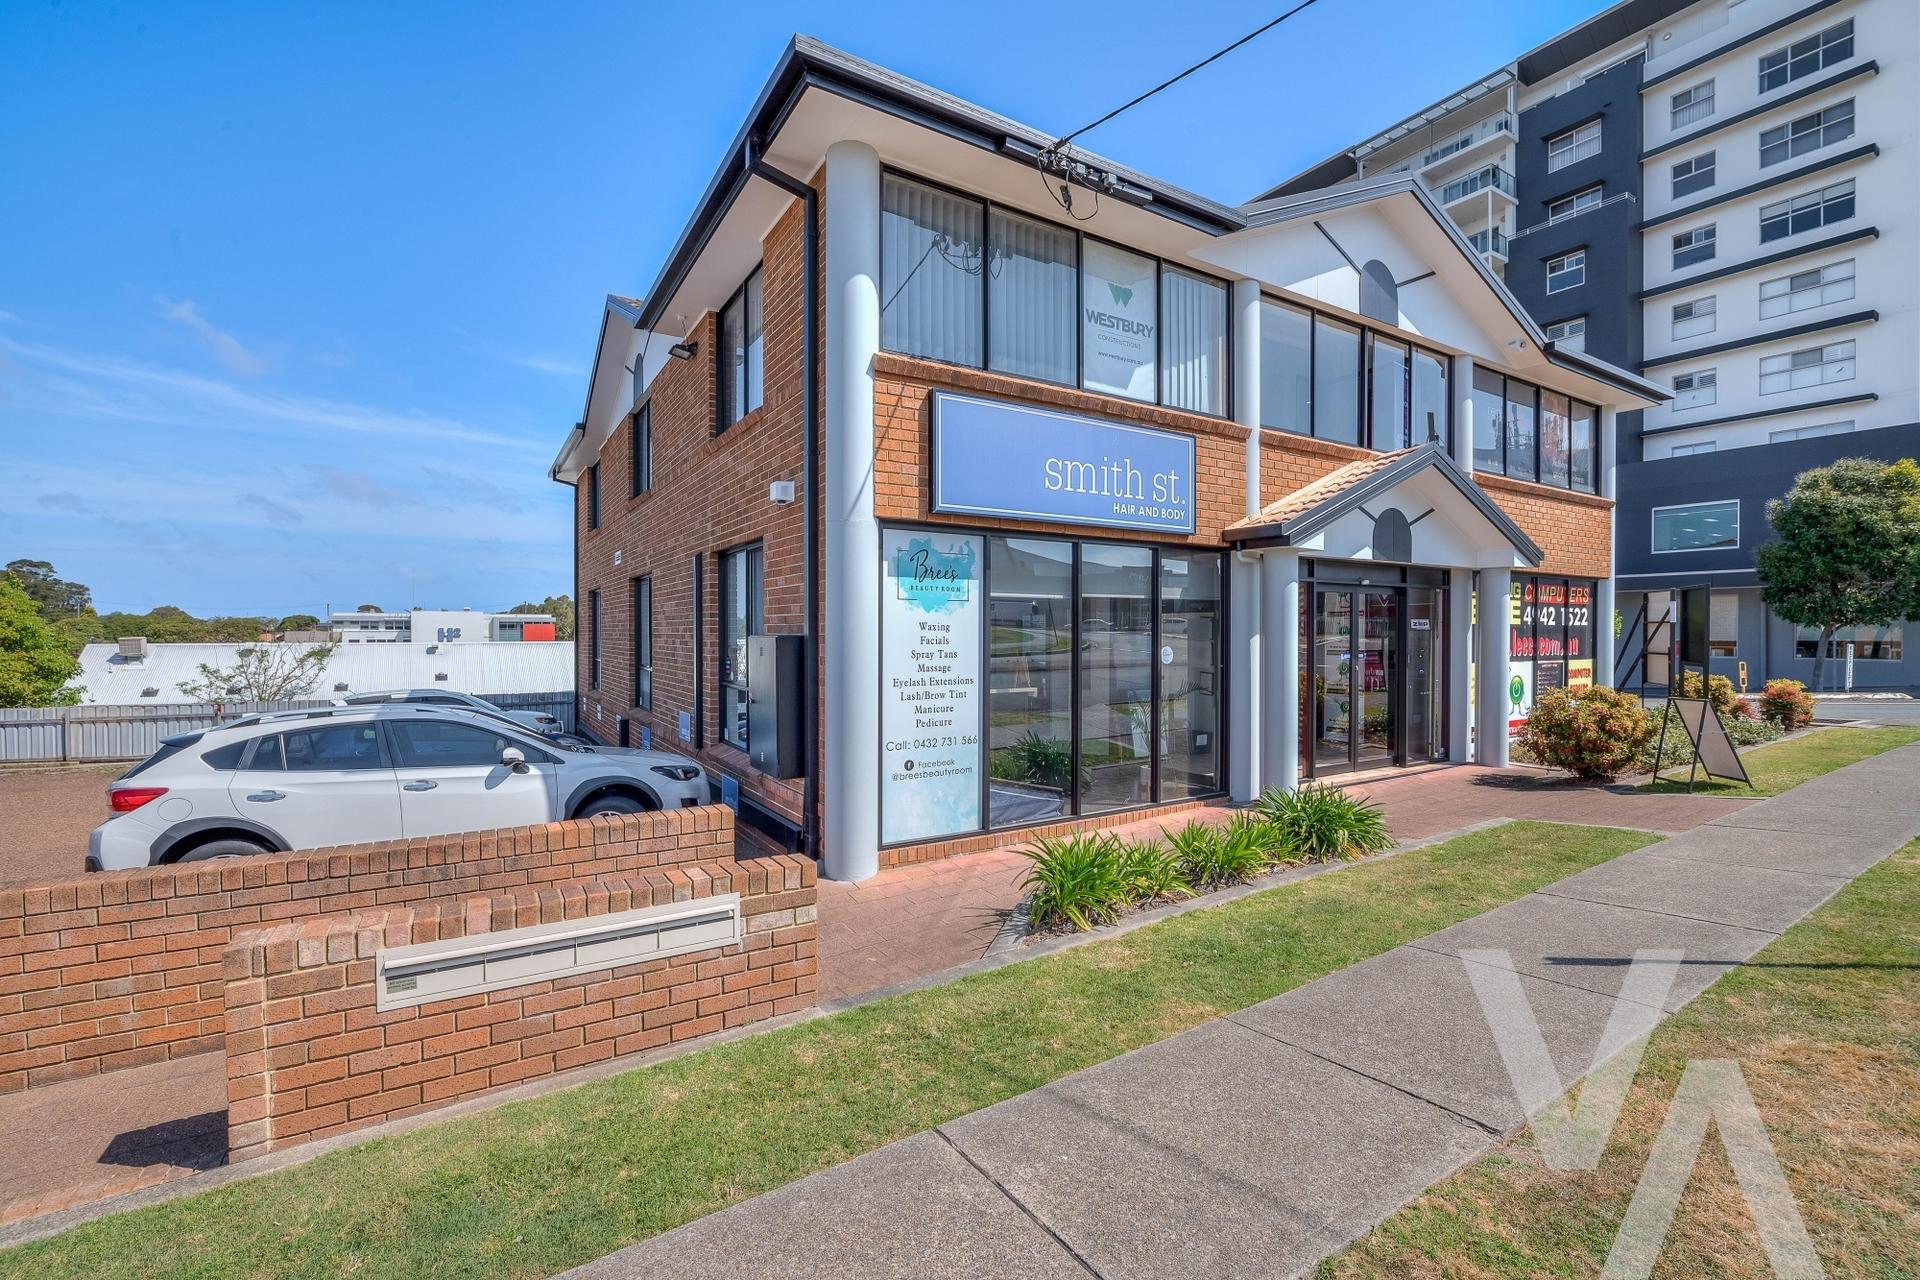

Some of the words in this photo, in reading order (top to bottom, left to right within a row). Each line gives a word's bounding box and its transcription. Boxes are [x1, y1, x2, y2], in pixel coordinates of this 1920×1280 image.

[1085, 308, 1154, 338] WESTBURY
[1045, 456, 1145, 500] smith
[1152, 469, 1186, 505] st.
[1113, 503, 1136, 515] HAIR
[1138, 506, 1159, 518] AND
[1161, 508, 1186, 520] BODY
[909, 548, 959, 583] Bree's
[910, 584, 939, 592] BEAUTY
[941, 585, 961, 593] ROOM
[918, 621, 951, 634] Waxing
[919, 635, 950, 645] Facials
[910, 649, 935, 661] Spray
[937, 649, 958, 659] Tans
[917, 663, 952, 674] Massage
[892, 678, 926, 690] Eyelash
[929, 676, 974, 687] Extensions
[900, 690, 947, 702] Lash/Brow
[948, 689, 968, 699] Tint
[914, 704, 955, 715] Manicure
[915, 718, 953, 729] Pedicure
[885, 740, 911, 752] Call:
[913, 737, 938, 750] 0432
[940, 736, 957, 747] 731
[961, 735, 978, 745] 566
[892, 766, 973, 782] @breesbeautyroom
